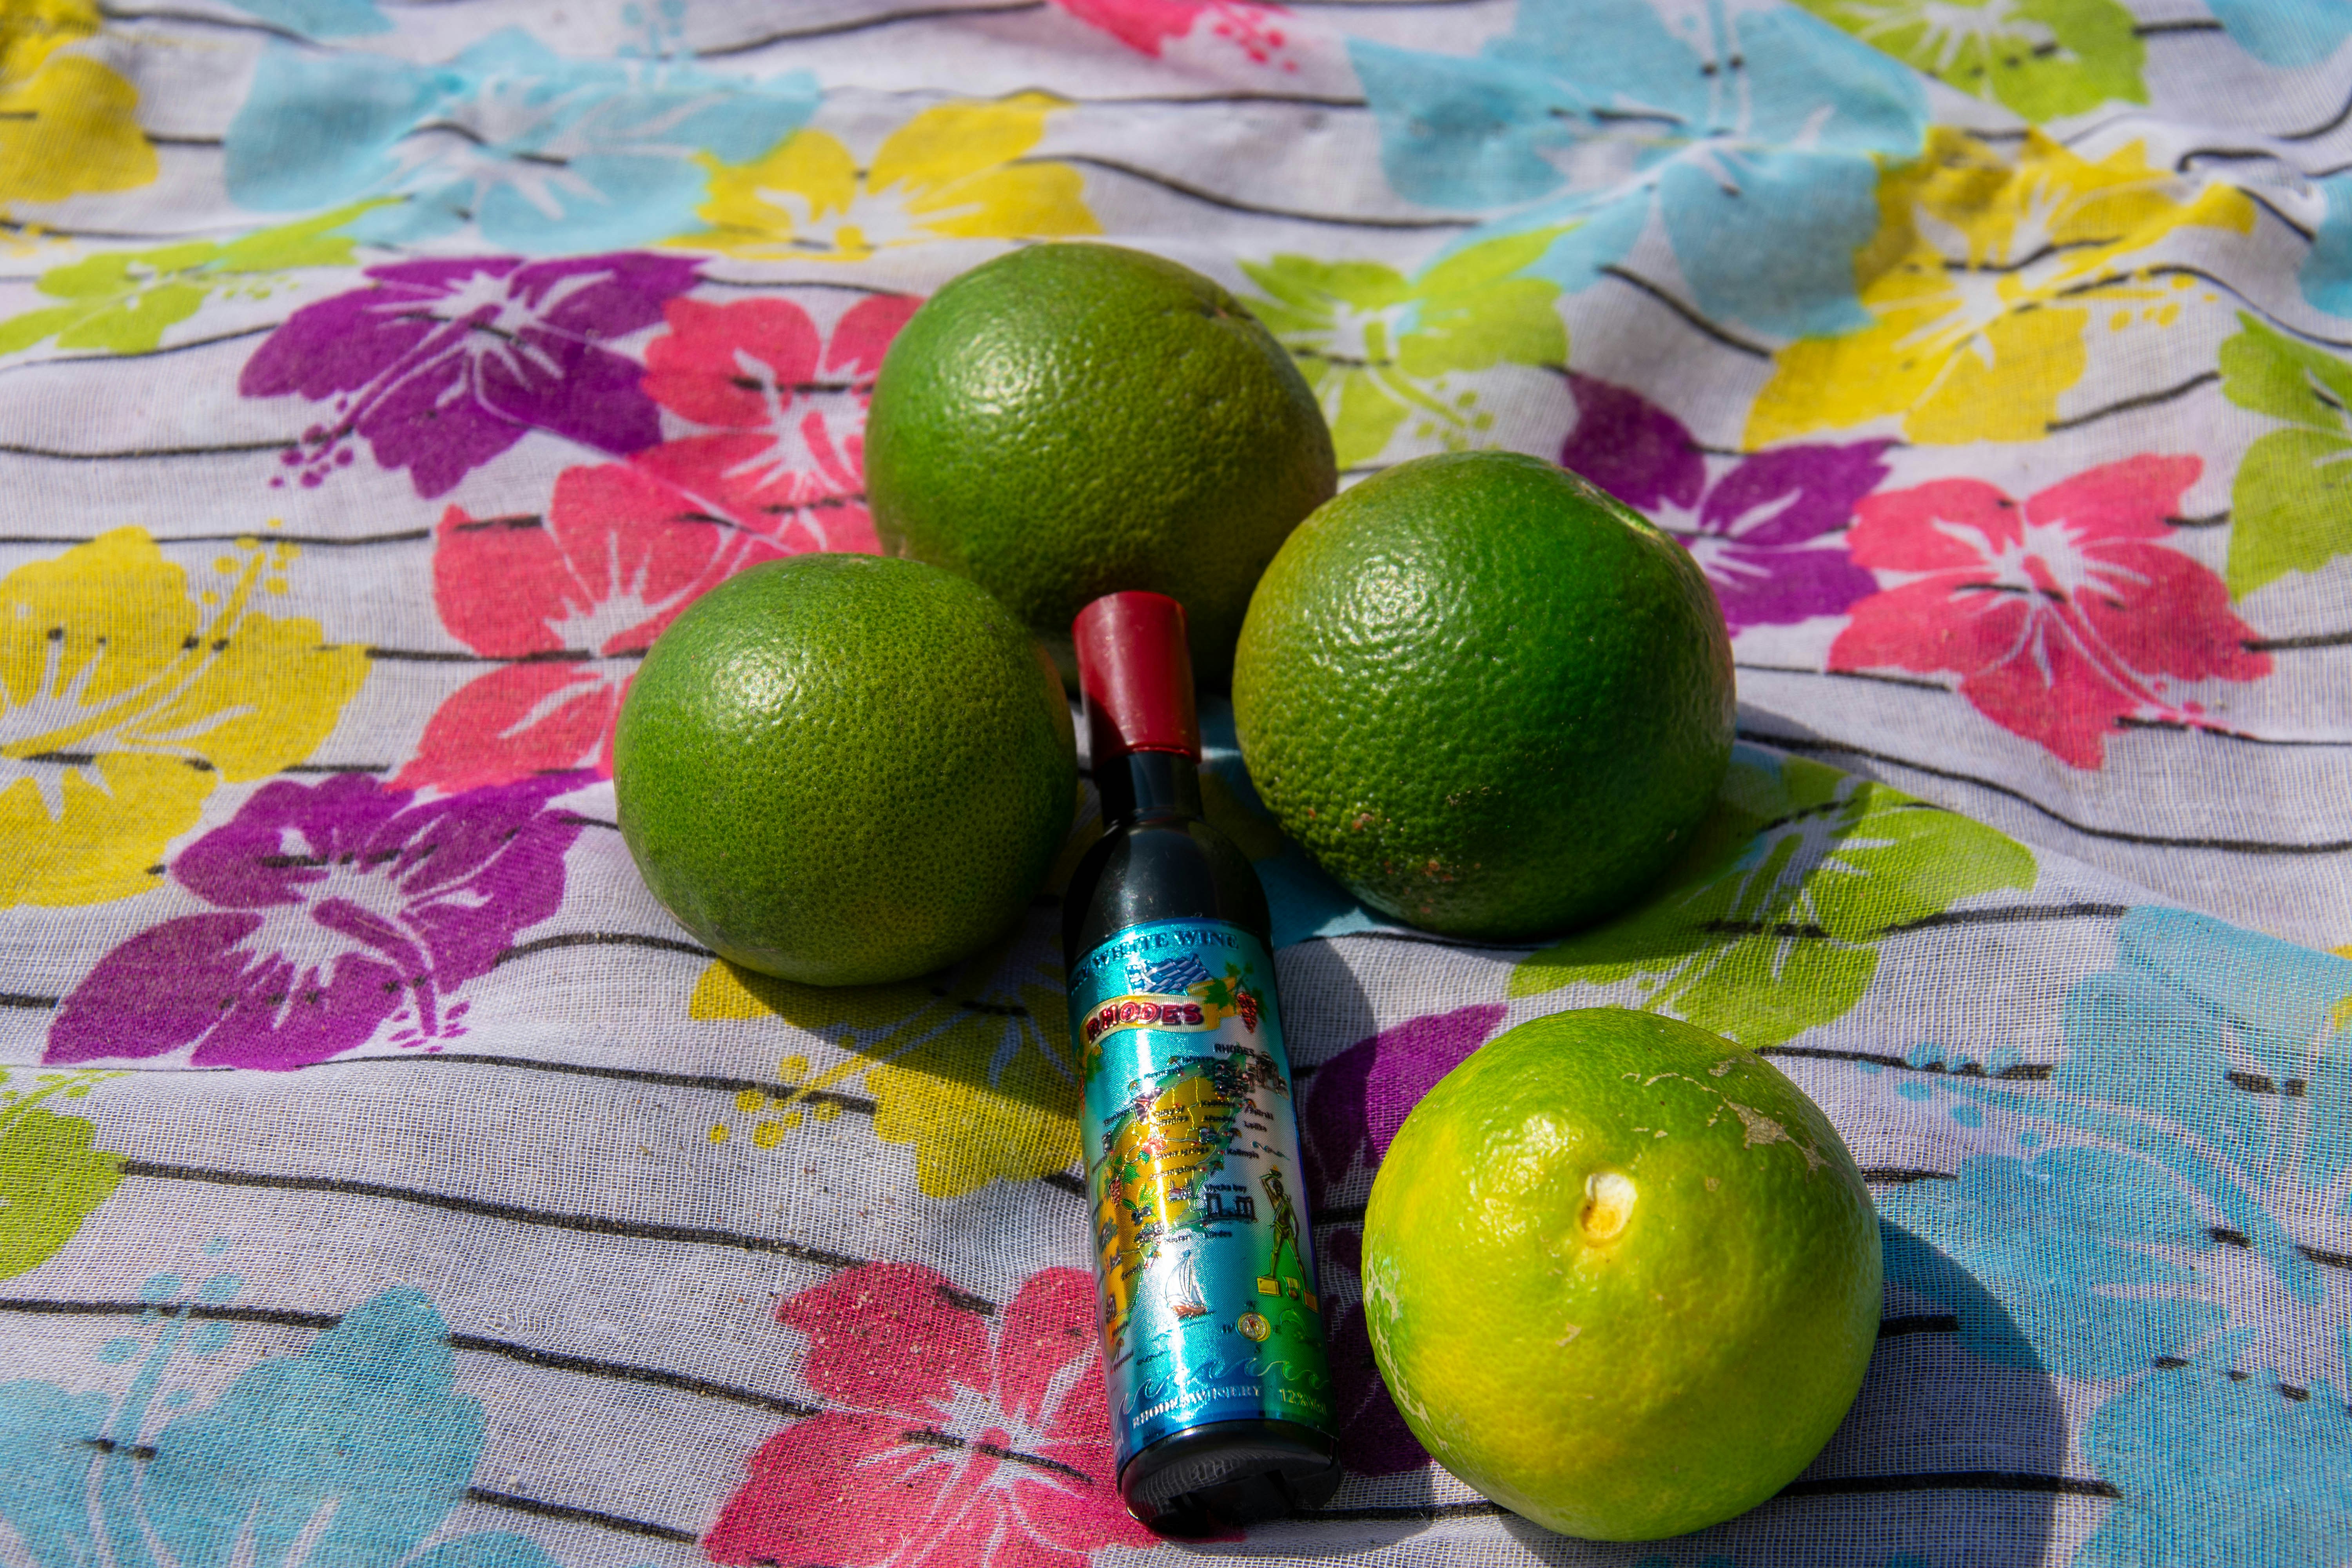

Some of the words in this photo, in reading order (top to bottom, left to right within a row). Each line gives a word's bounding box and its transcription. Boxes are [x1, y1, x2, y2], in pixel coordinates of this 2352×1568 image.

[1092, 932, 1169, 969] WHITE
[1173, 930, 1239, 950] WINE
[1087, 1002, 1203, 1044] RHODES
[1213, 1043, 1255, 1056] RHODES
